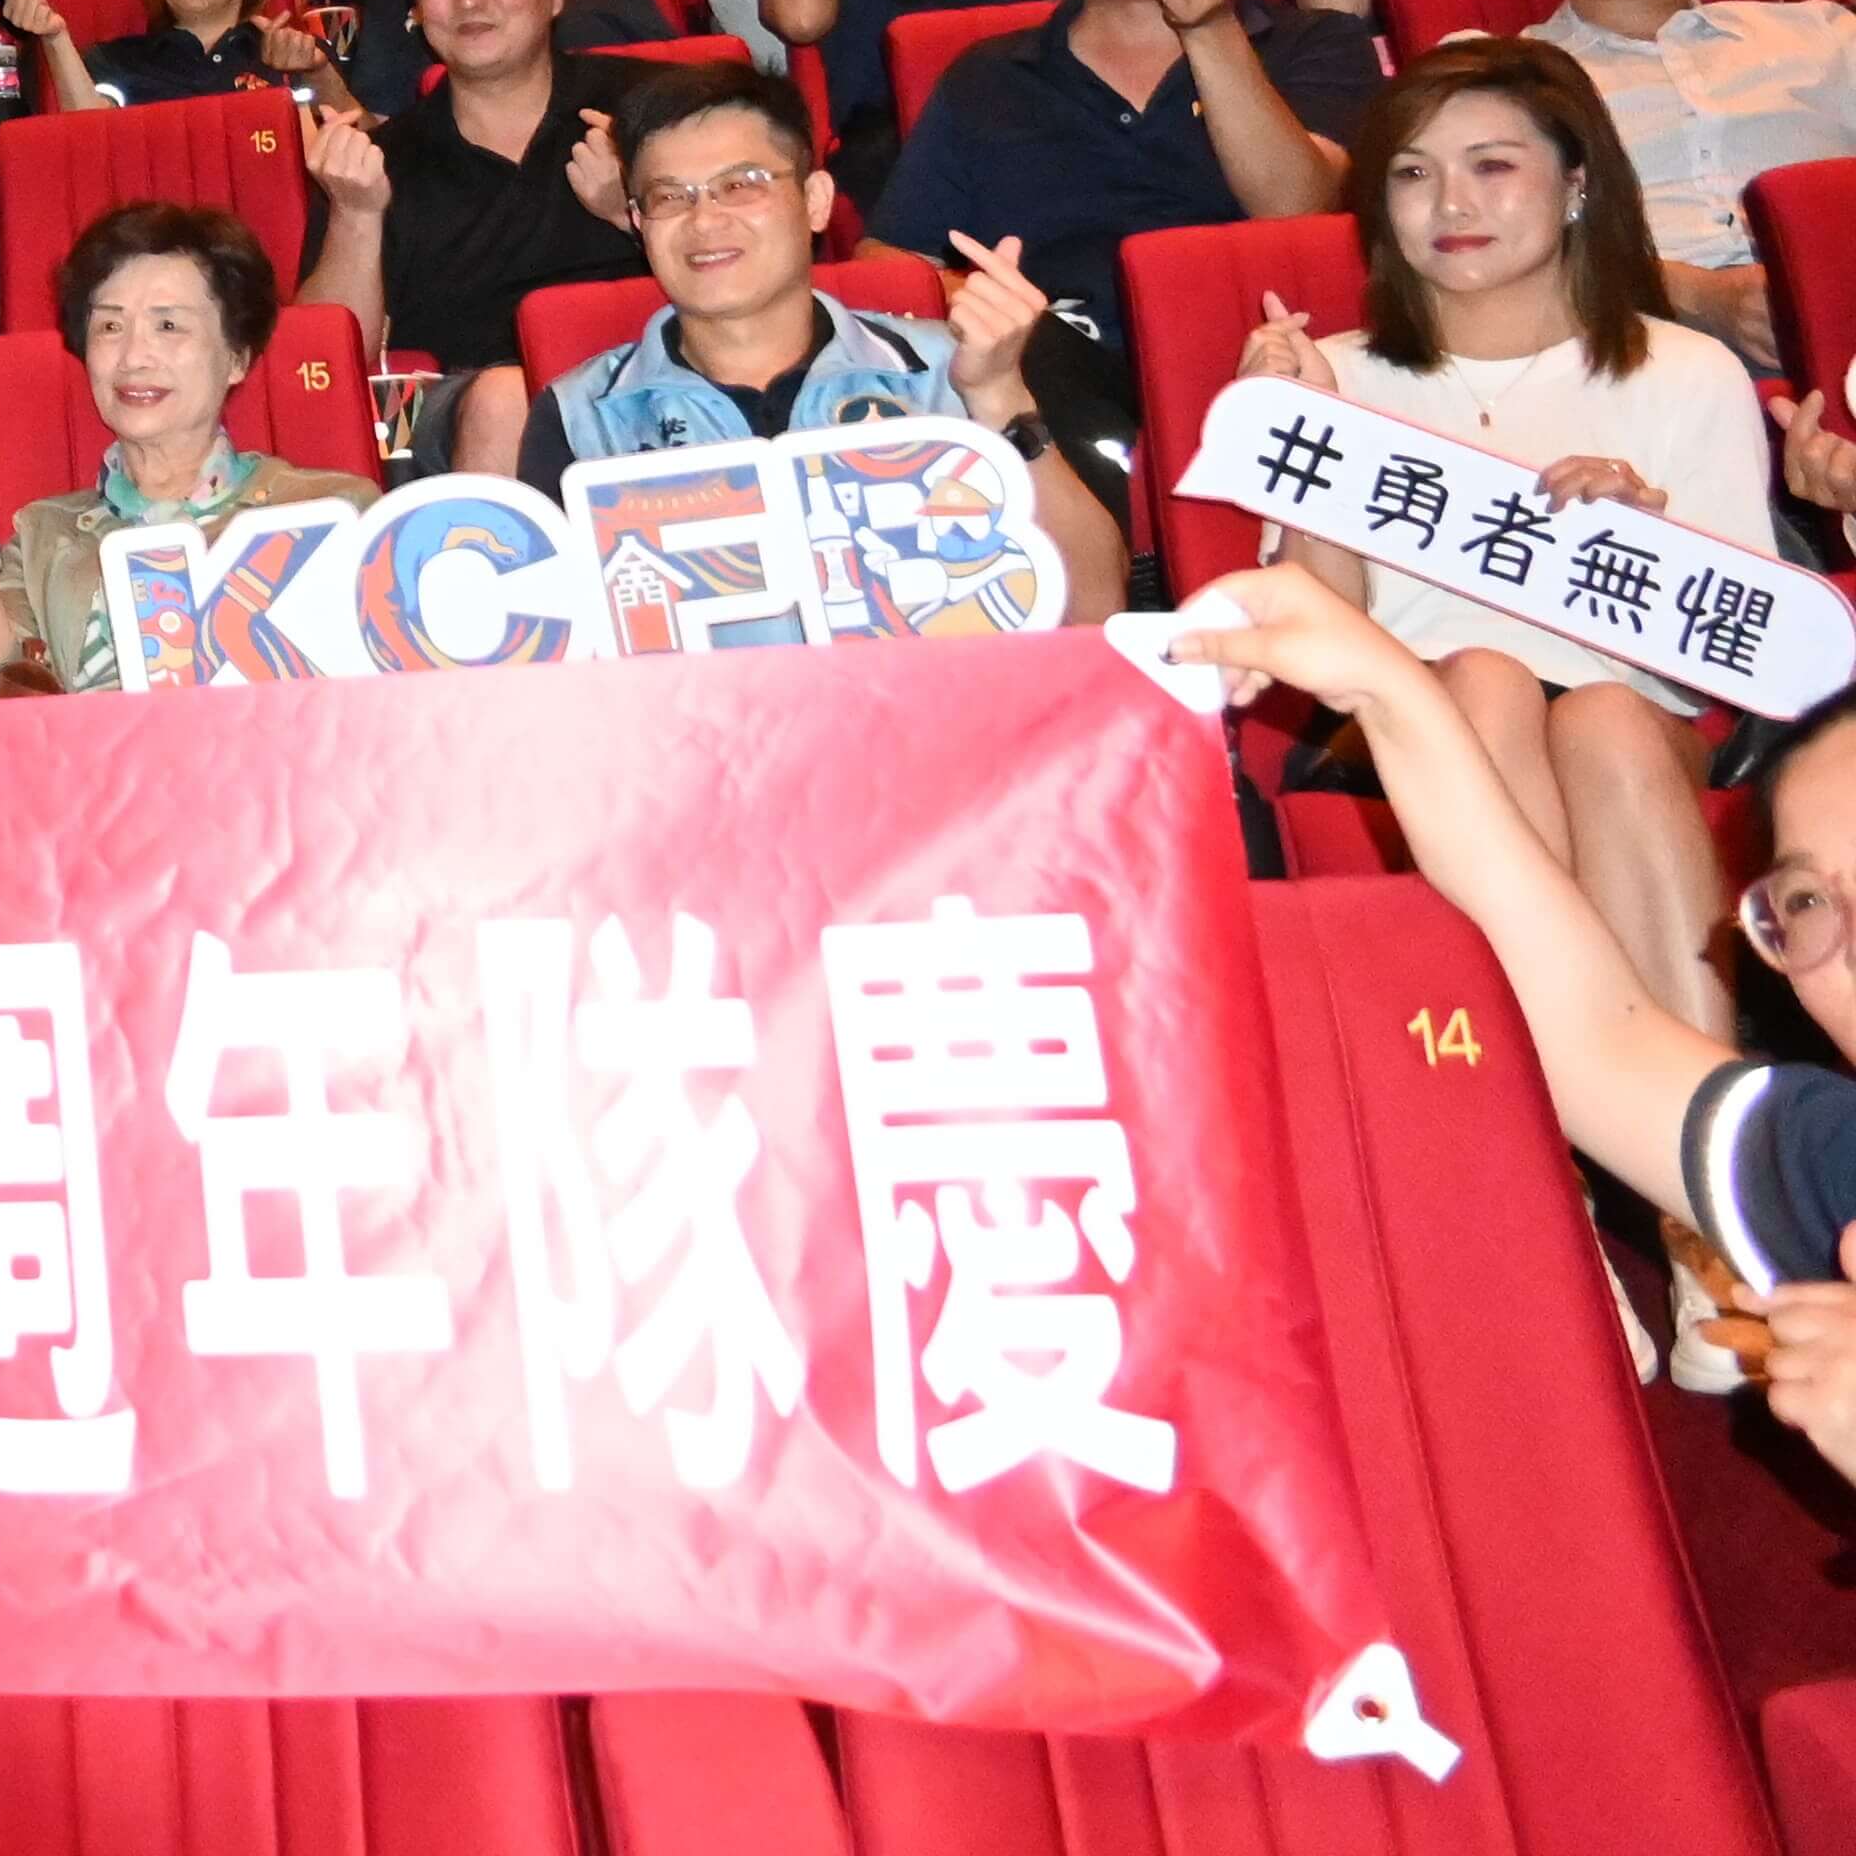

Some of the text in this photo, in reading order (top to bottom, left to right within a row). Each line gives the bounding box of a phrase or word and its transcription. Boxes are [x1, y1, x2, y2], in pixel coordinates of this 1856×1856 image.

[249, 129, 278, 154] 15
[296, 360, 331, 391] 15
[1256, 413, 1775, 678] #勇者無懼
[1406, 1006, 1484, 1068] 14
